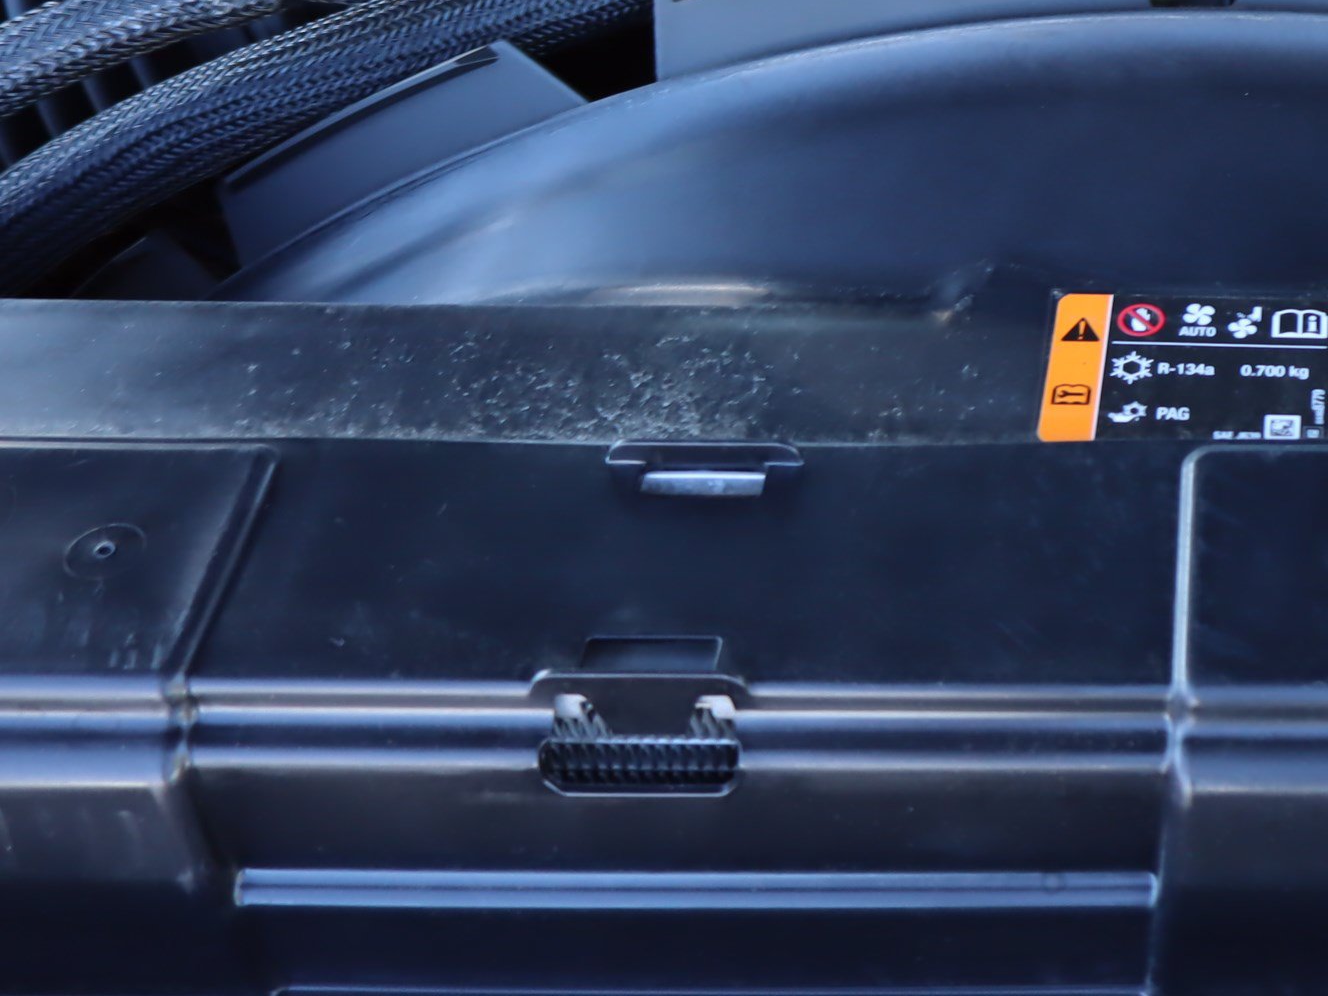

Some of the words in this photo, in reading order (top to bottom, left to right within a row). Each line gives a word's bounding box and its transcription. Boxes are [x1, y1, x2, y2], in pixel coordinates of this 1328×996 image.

[1178, 326, 1217, 338] AUTO
[1157, 362, 1216, 376] R-134a
[1239, 364, 1286, 378] 0.700
[1288, 365, 1310, 380] kg
[1155, 406, 1191, 421] PAG
